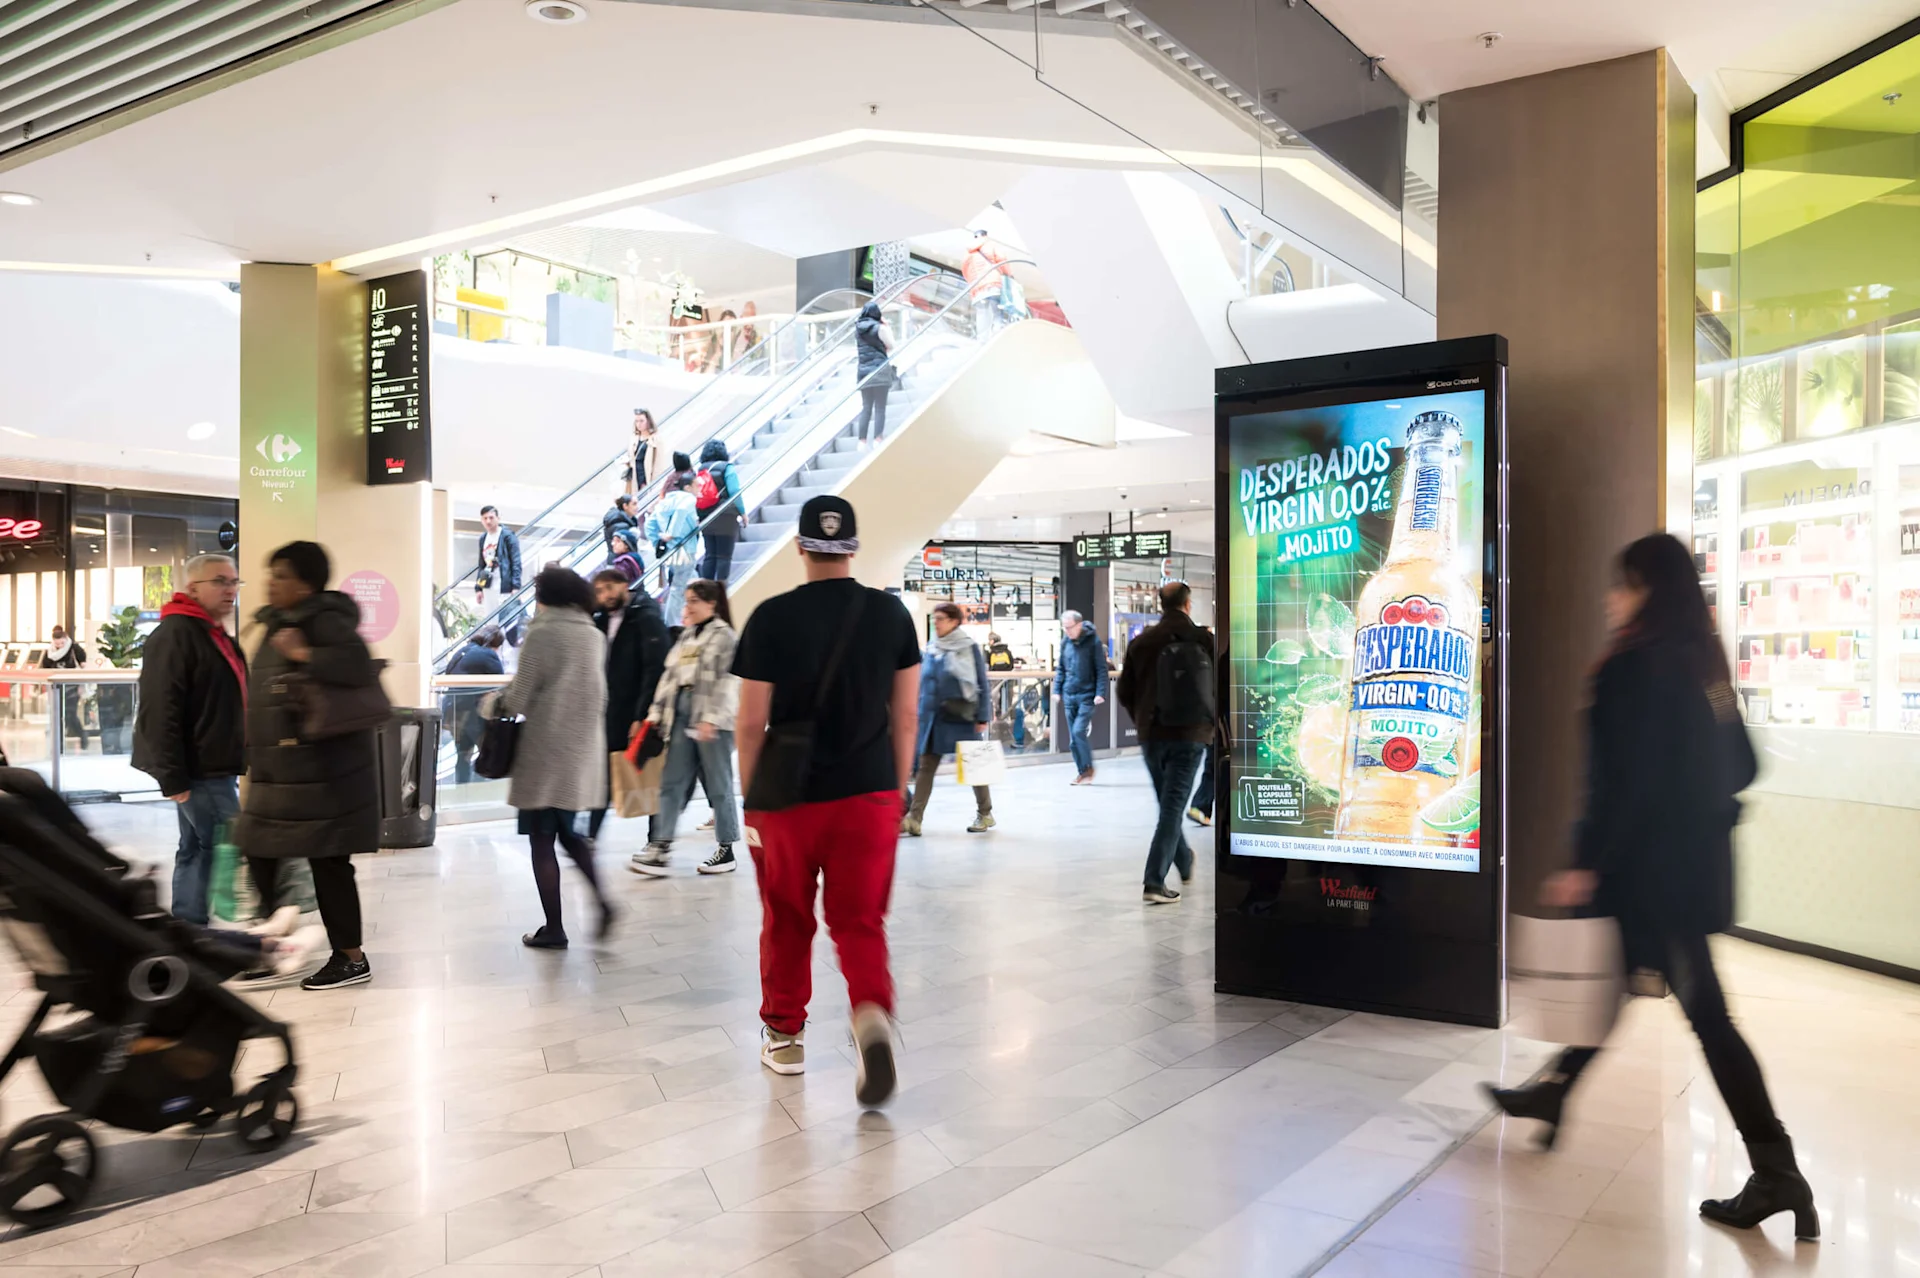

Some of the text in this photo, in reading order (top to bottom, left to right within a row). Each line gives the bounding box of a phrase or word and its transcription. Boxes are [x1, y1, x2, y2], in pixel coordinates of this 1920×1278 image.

[250, 466, 307, 478] Carrefour
[1240, 437, 1392, 503] DESPERADOS
[262, 480, 296, 489] Niveau 2
[1412, 467, 1441, 530] DESPERADOS
[1242, 489, 1325, 537] VIRGIN
[922, 568, 985, 580] COURIR
[1354, 625, 1471, 679] DESPERADOS
[1358, 683, 1418, 706] VIRGIN
[1371, 718, 1439, 738] MOJITO
[1235, 839, 1253, 847] L'ABUS
[1254, 840, 1281, 848] D'ALCOOL
[1281, 841, 1292, 849] EST
[1293, 842, 1326, 852] DANGEREUX
[1326, 844, 1342, 852] POUR
[1343, 845, 1351, 853] LA
[1379, 848, 1417, 858] CONSOMMER
[1418, 850, 1434, 860] AVEC
[1319, 877, 1378, 900] Westfield
[1326, 898, 1370, 911] LA PART-DIEU
